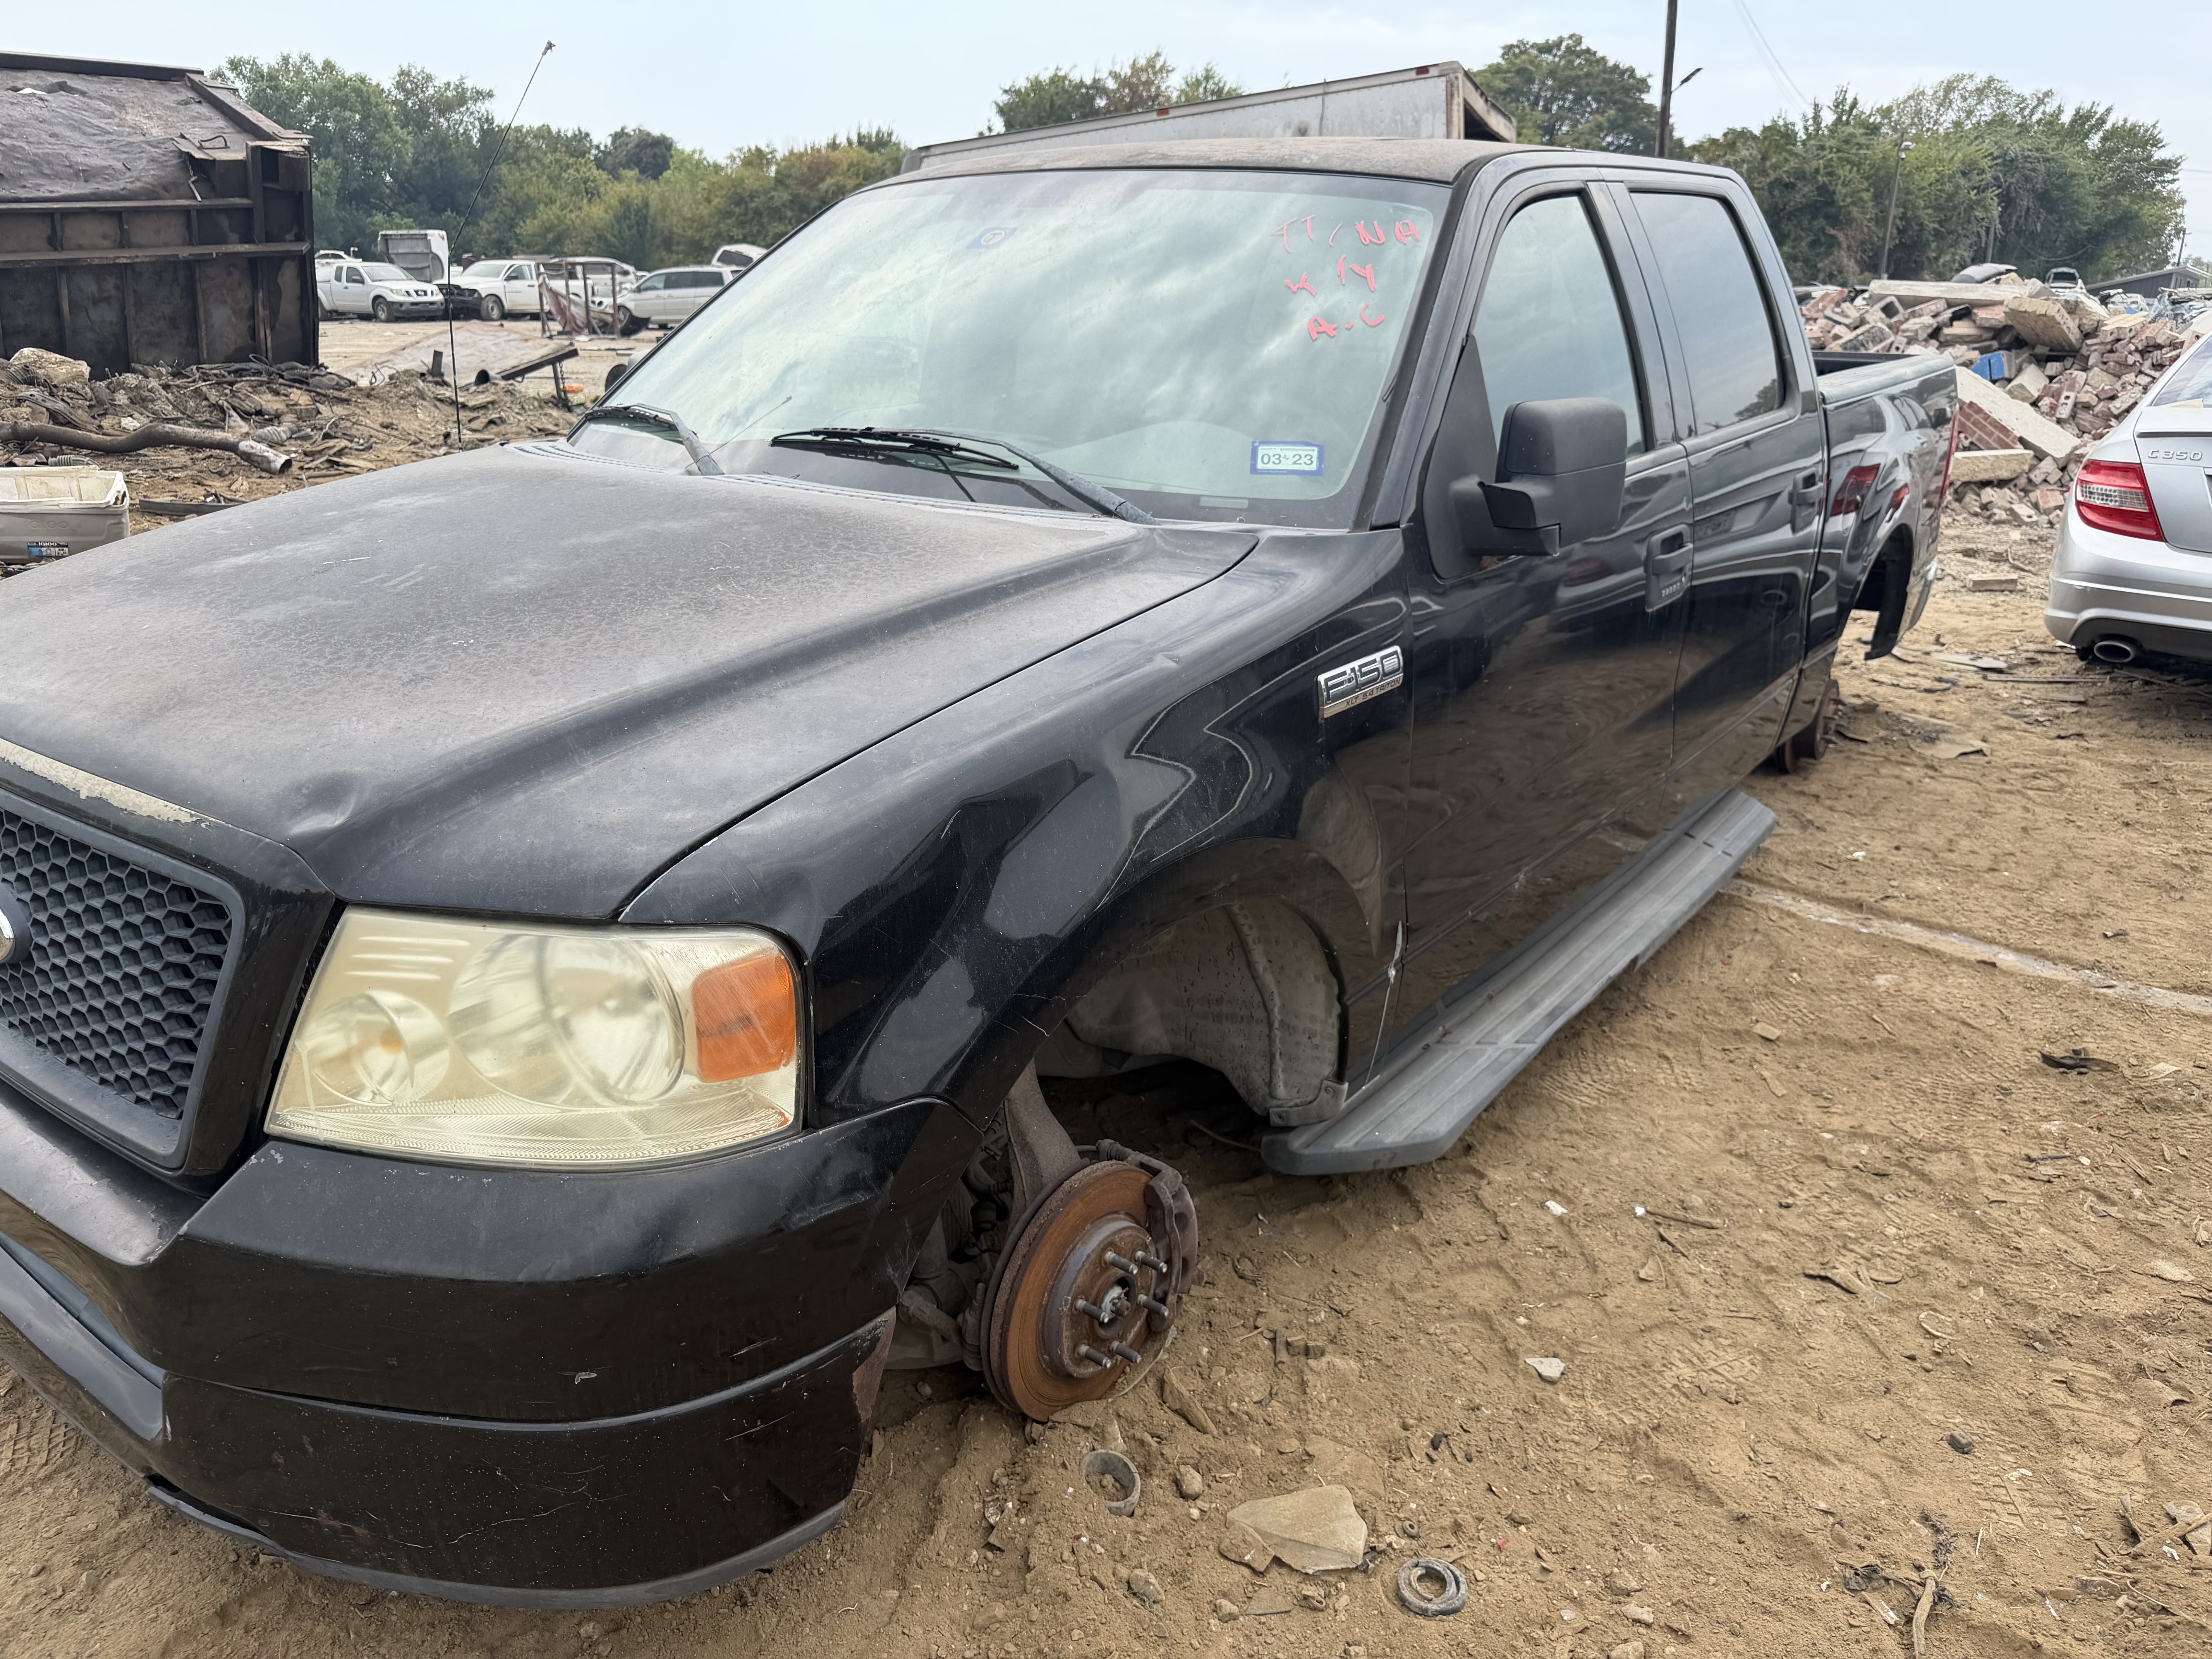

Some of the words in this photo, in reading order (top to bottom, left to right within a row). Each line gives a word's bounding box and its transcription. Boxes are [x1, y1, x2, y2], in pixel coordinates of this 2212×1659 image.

[1261, 453, 1282, 465] 03
[1292, 454, 1314, 465] 23
[1344, 696, 1359, 707] XLT
[1375, 678, 1401, 694] TRITON
